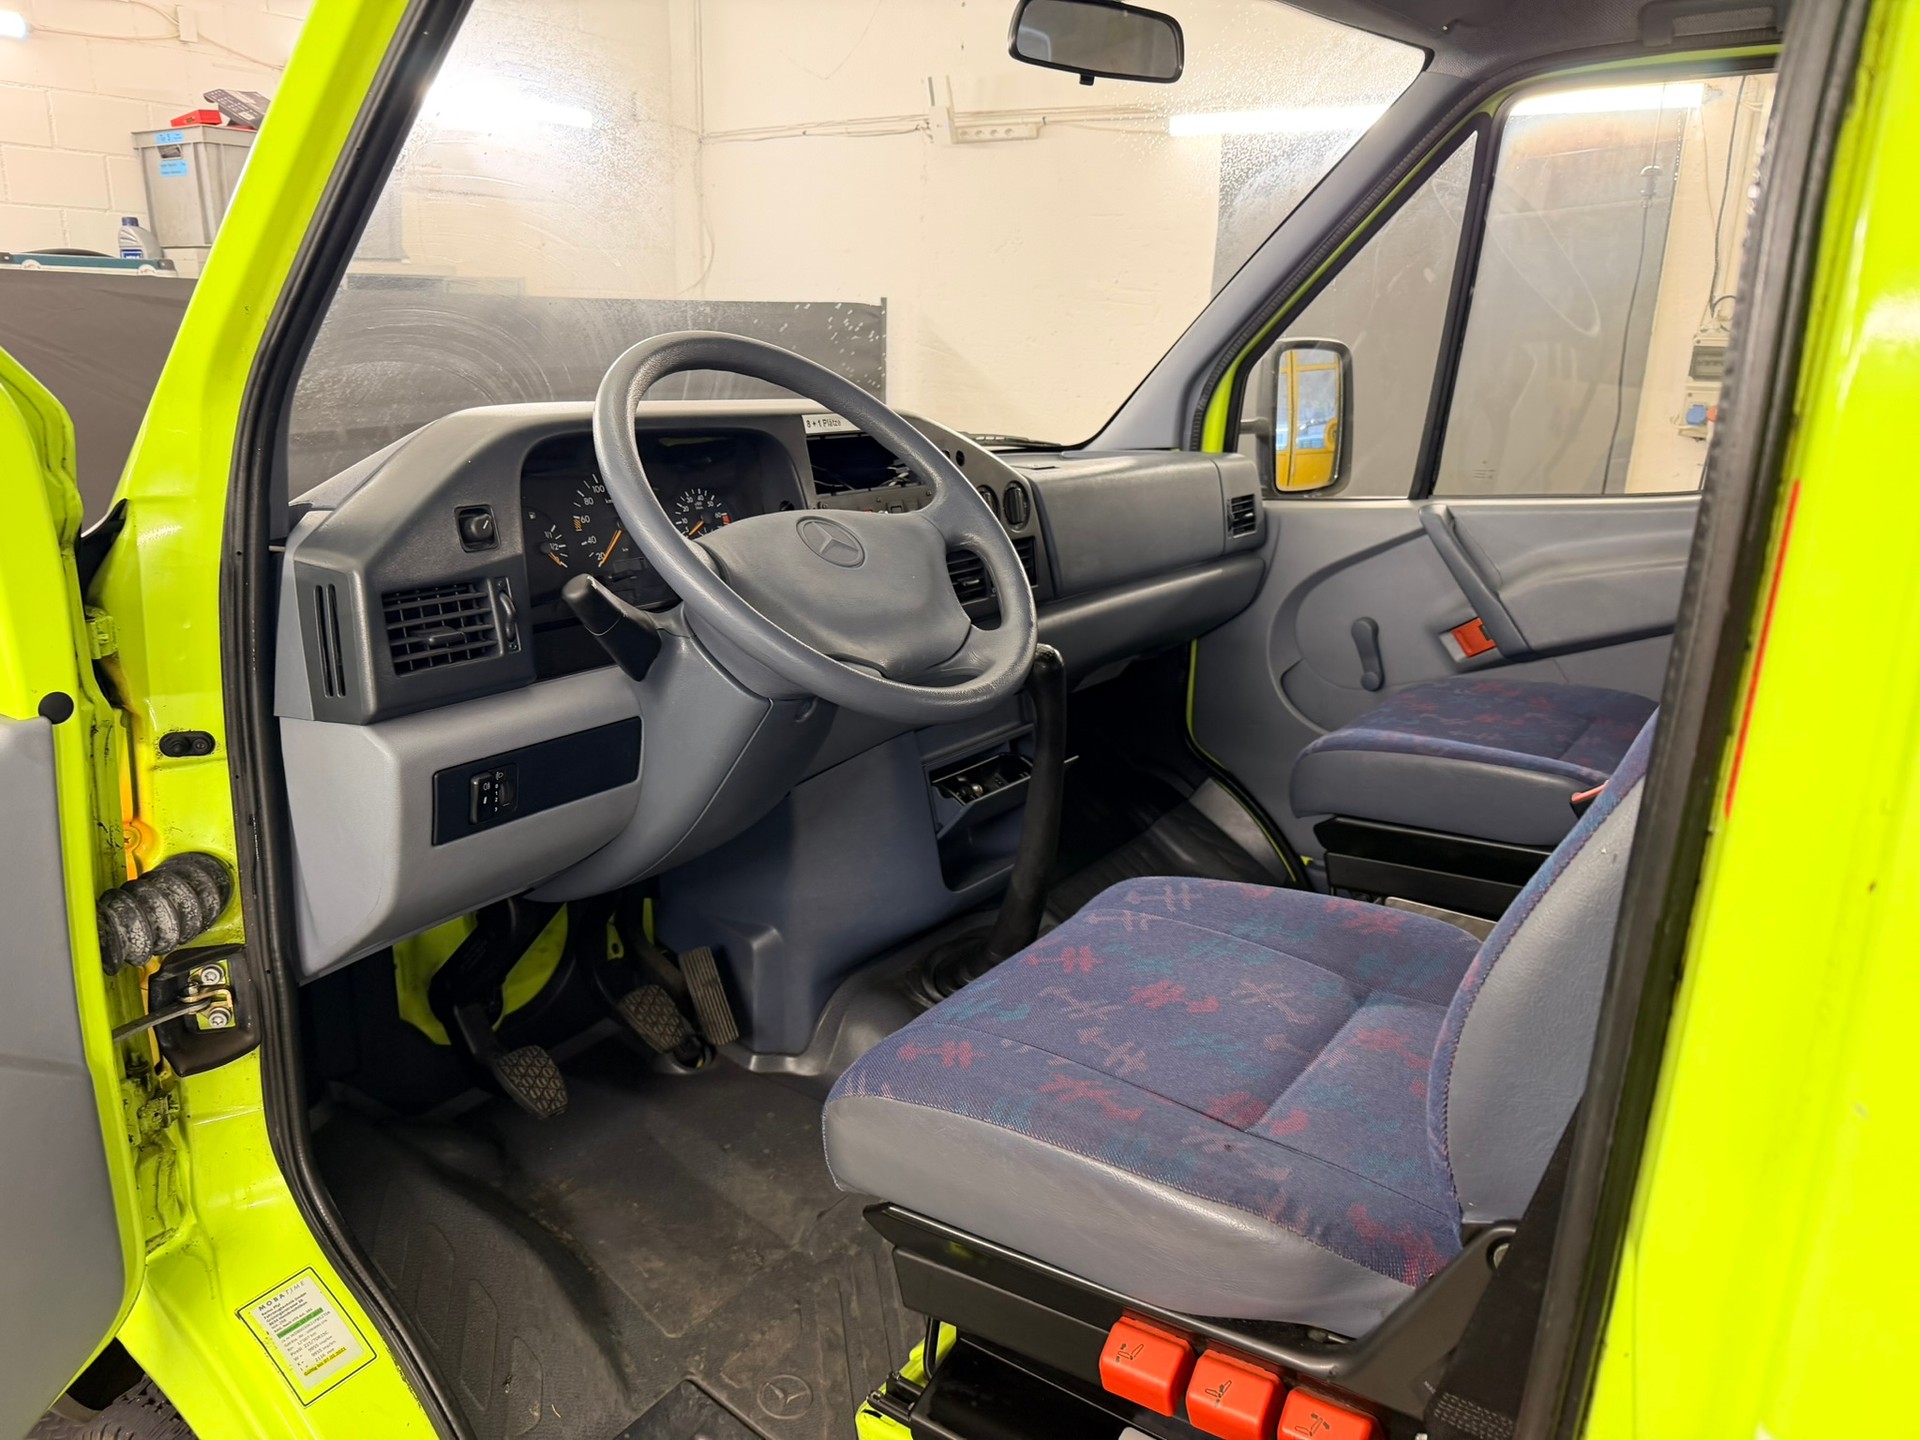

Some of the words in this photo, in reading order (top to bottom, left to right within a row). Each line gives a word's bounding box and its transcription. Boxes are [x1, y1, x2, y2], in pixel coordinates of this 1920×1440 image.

[806, 419, 811, 428] 8
[822, 419, 841, 427] Plätze
[592, 484, 605, 494] 100
[583, 497, 594, 506] 80
[686, 496, 694, 504] 30
[707, 500, 714, 508] 50
[580, 515, 591, 524] 60
[714, 511, 722, 519] 60
[587, 535, 598, 545] 40
[595, 551, 606, 561] 20
